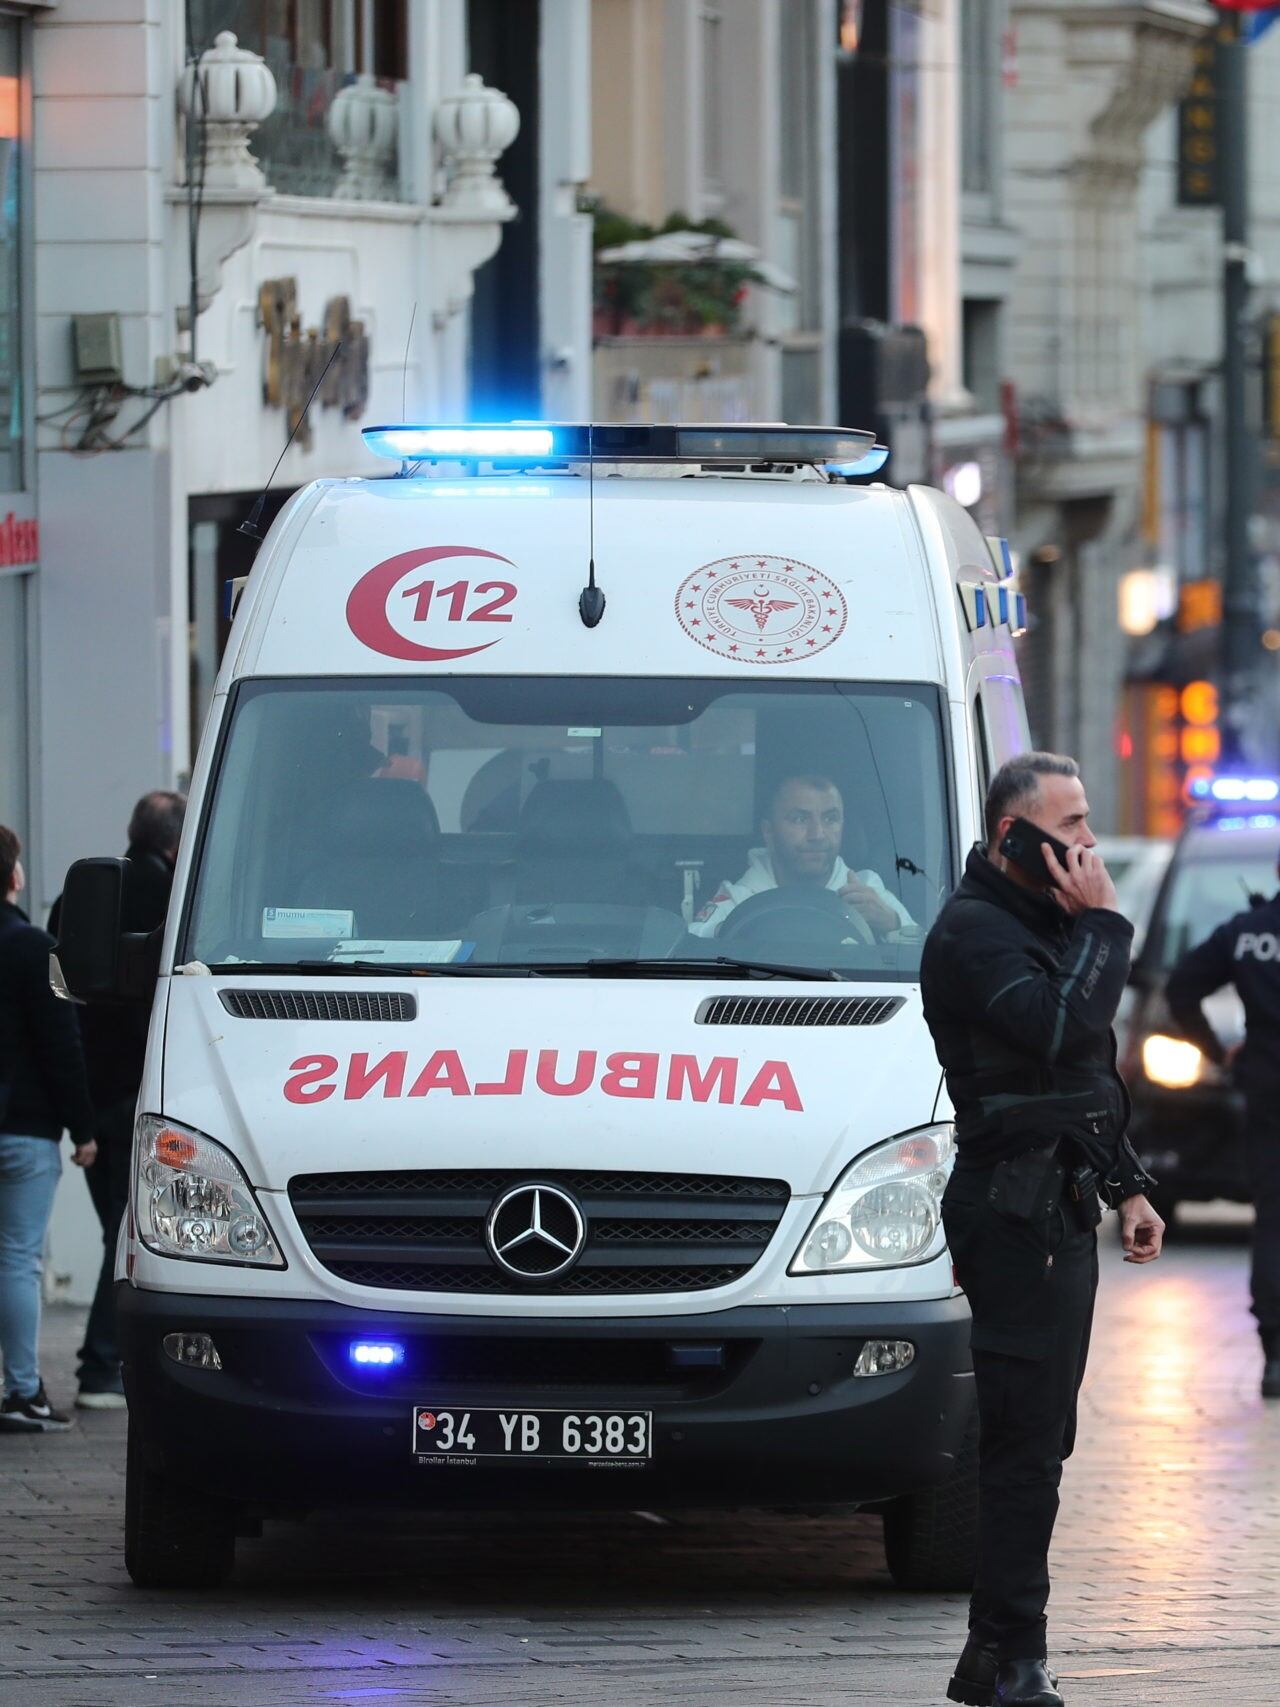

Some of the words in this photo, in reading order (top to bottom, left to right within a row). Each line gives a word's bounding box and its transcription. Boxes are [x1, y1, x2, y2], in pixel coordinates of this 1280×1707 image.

[401, 580, 518, 622] 112
[436, 1412, 476, 1450] 34
[498, 1414, 541, 1452] YB
[562, 1415, 646, 1453] 6383
